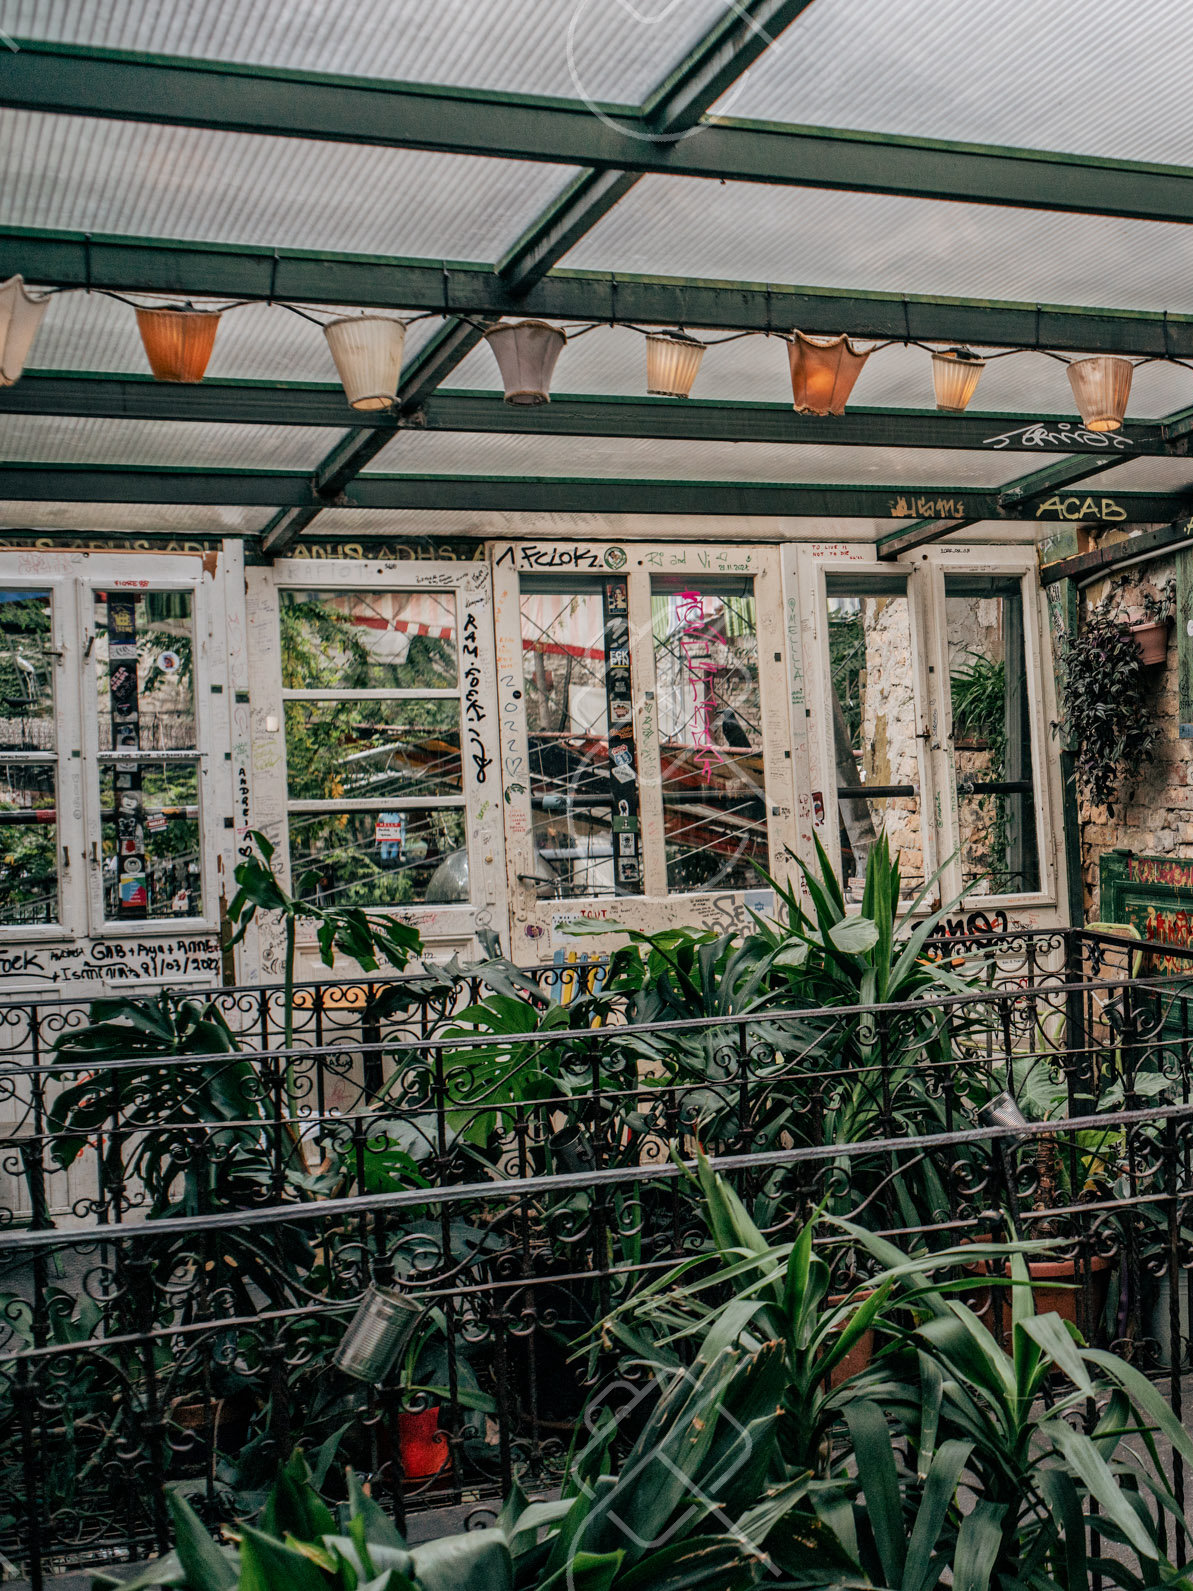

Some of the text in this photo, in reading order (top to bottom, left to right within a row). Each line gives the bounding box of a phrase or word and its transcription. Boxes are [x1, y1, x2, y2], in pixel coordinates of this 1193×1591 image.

[1036, 498, 1128, 521] ACAB
[610, 651, 629, 659] FCK
[610, 658, 630, 666] PTN
[91, 941, 126, 961] GAB
